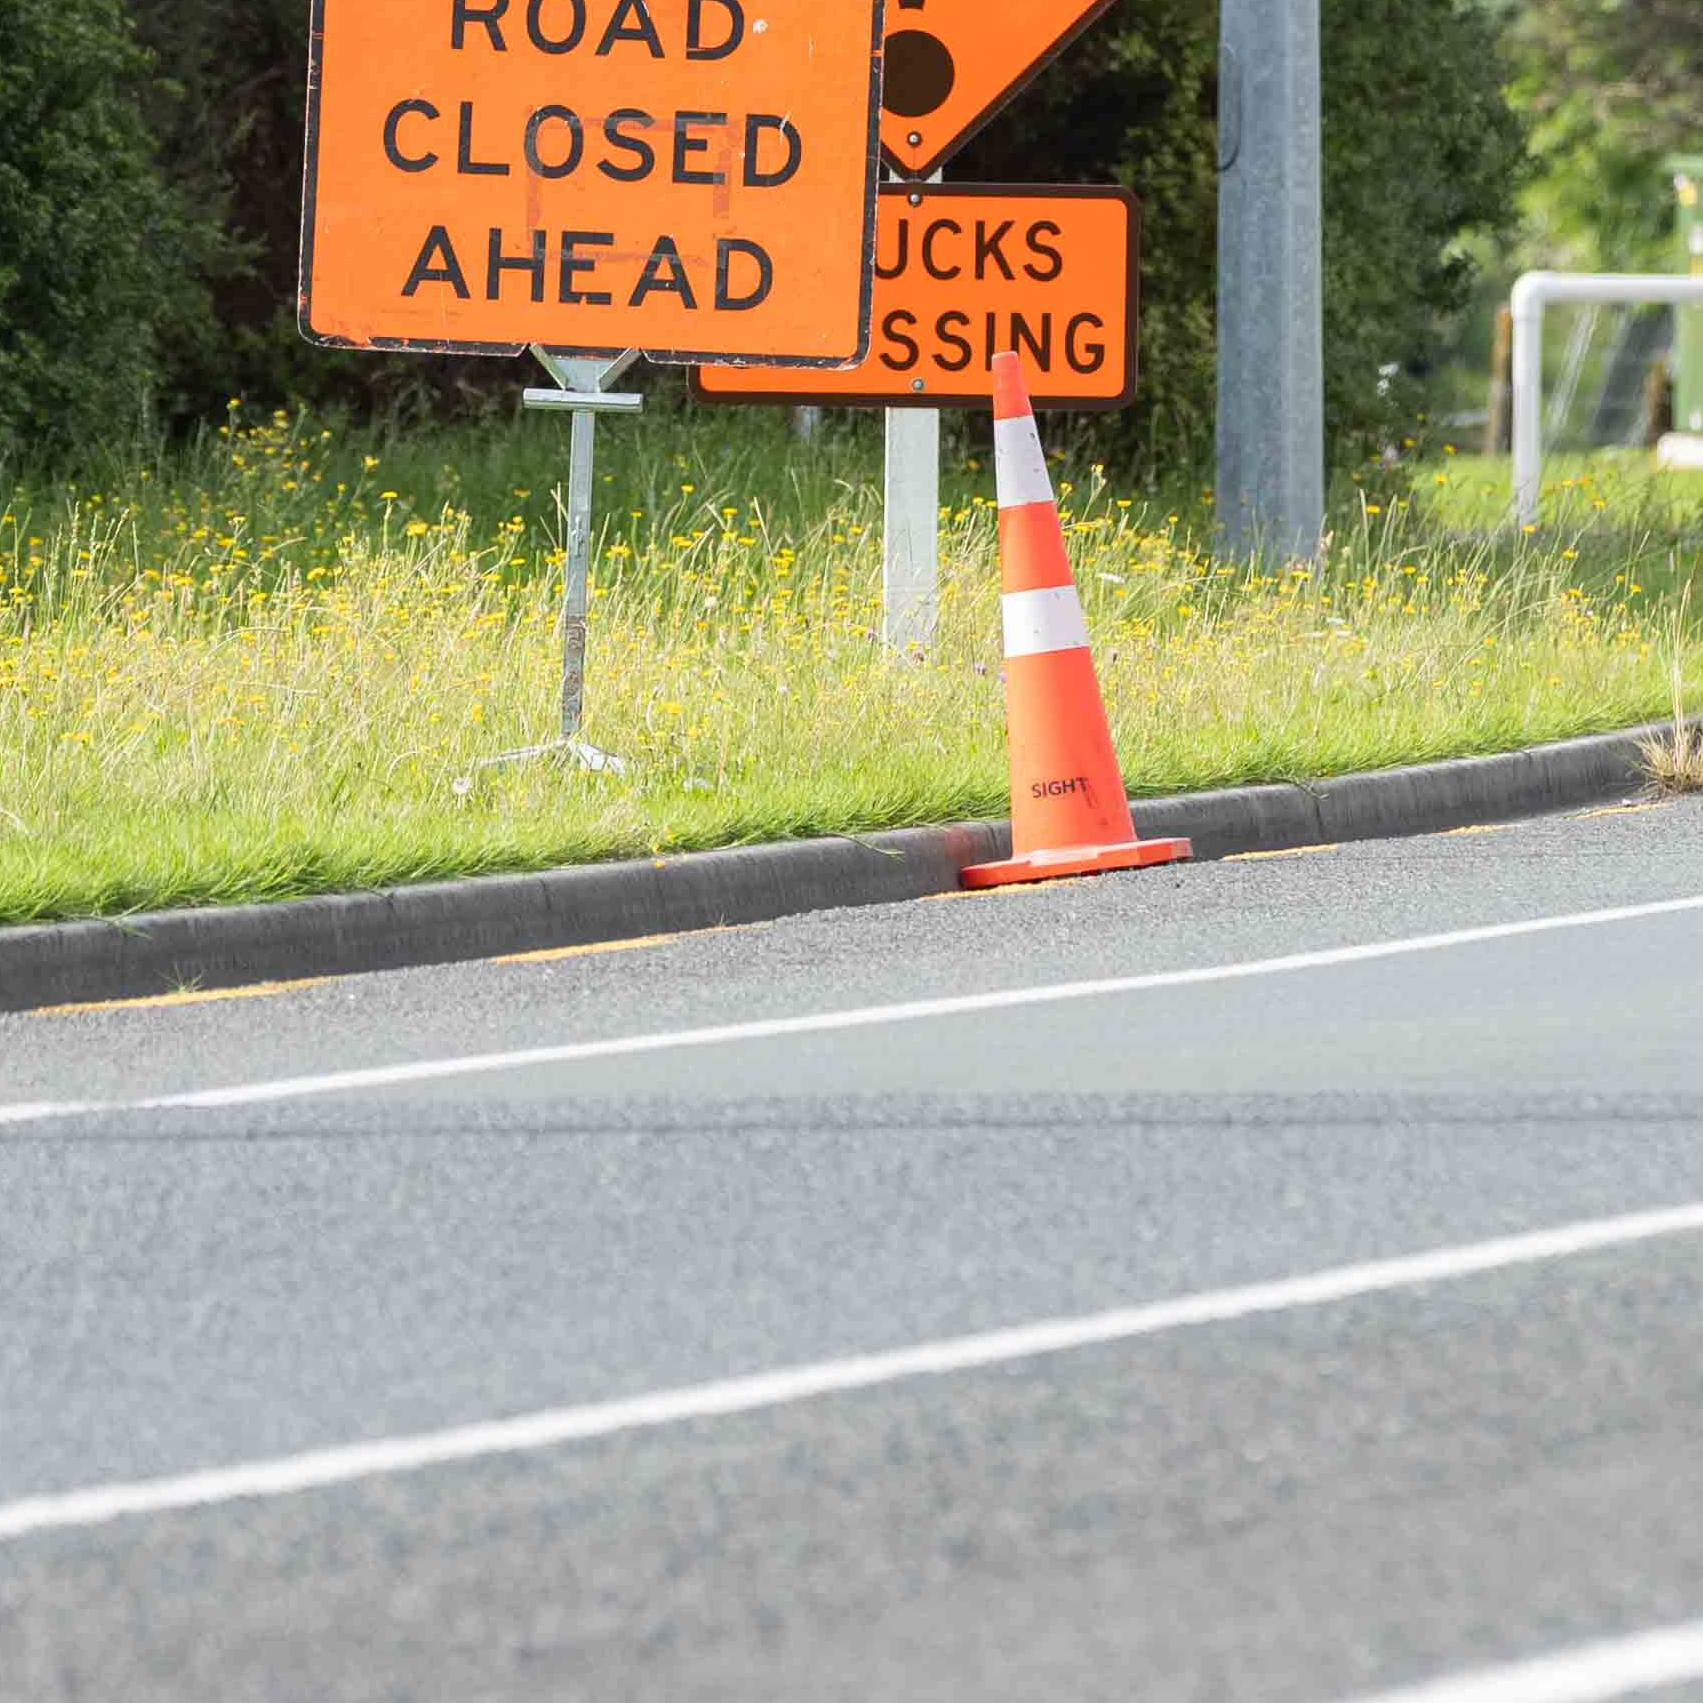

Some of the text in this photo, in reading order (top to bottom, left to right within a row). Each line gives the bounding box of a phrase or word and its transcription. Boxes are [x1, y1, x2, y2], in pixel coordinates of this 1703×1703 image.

[382, 97, 803, 187] CLOSED
[400, 225, 774, 311] AHEAD
[873, 218, 1064, 282] UCKS
[878, 309, 1106, 375] SSING
[1031, 776, 1089, 799] SIGHT
